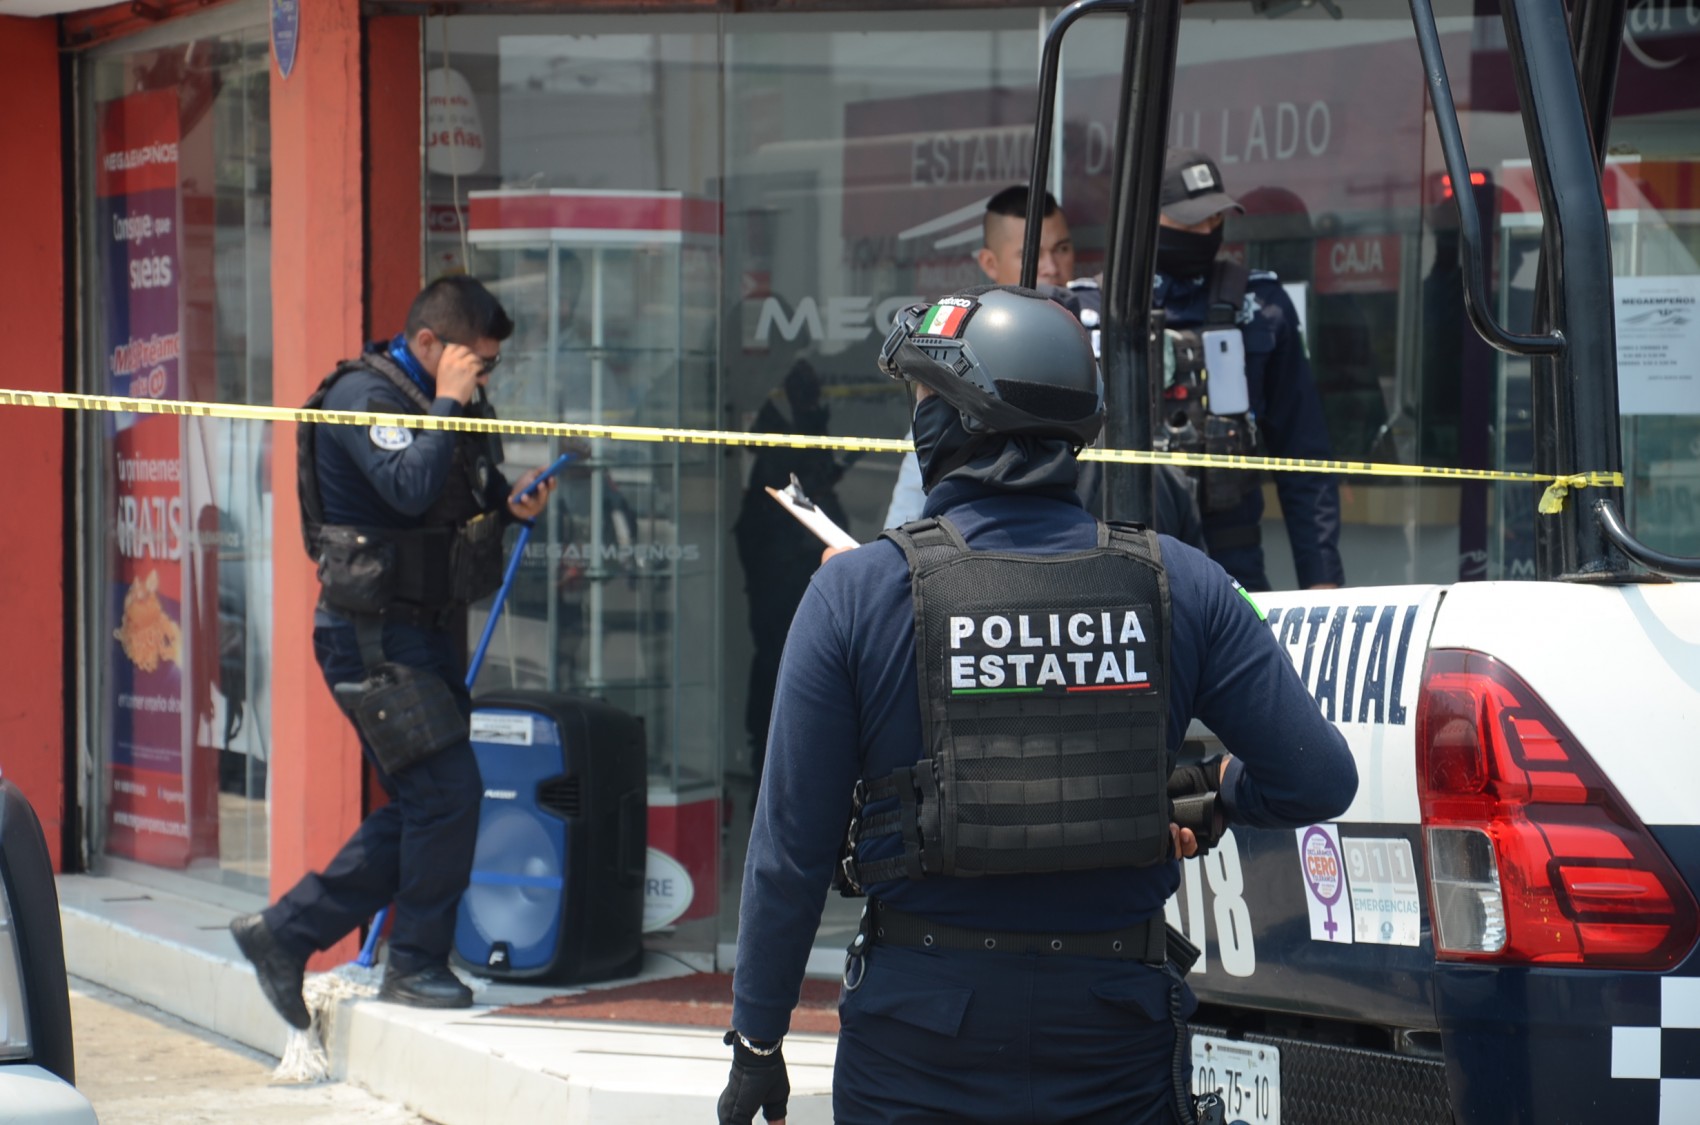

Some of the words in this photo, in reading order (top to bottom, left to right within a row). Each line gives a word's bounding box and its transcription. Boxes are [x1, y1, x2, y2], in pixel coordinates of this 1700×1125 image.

[911, 130, 1033, 188] ESTAM
[1220, 100, 1332, 165] LADO
[1329, 239, 1384, 275] CAJA
[949, 610, 1146, 649] POLICIA
[950, 649, 1148, 688] ESTATAL
[1266, 604, 1419, 725] STATAL
[1307, 855, 1337, 877] CERO
[1350, 847, 1407, 879] 911
[1353, 898, 1419, 914] EMERGENCIAS
